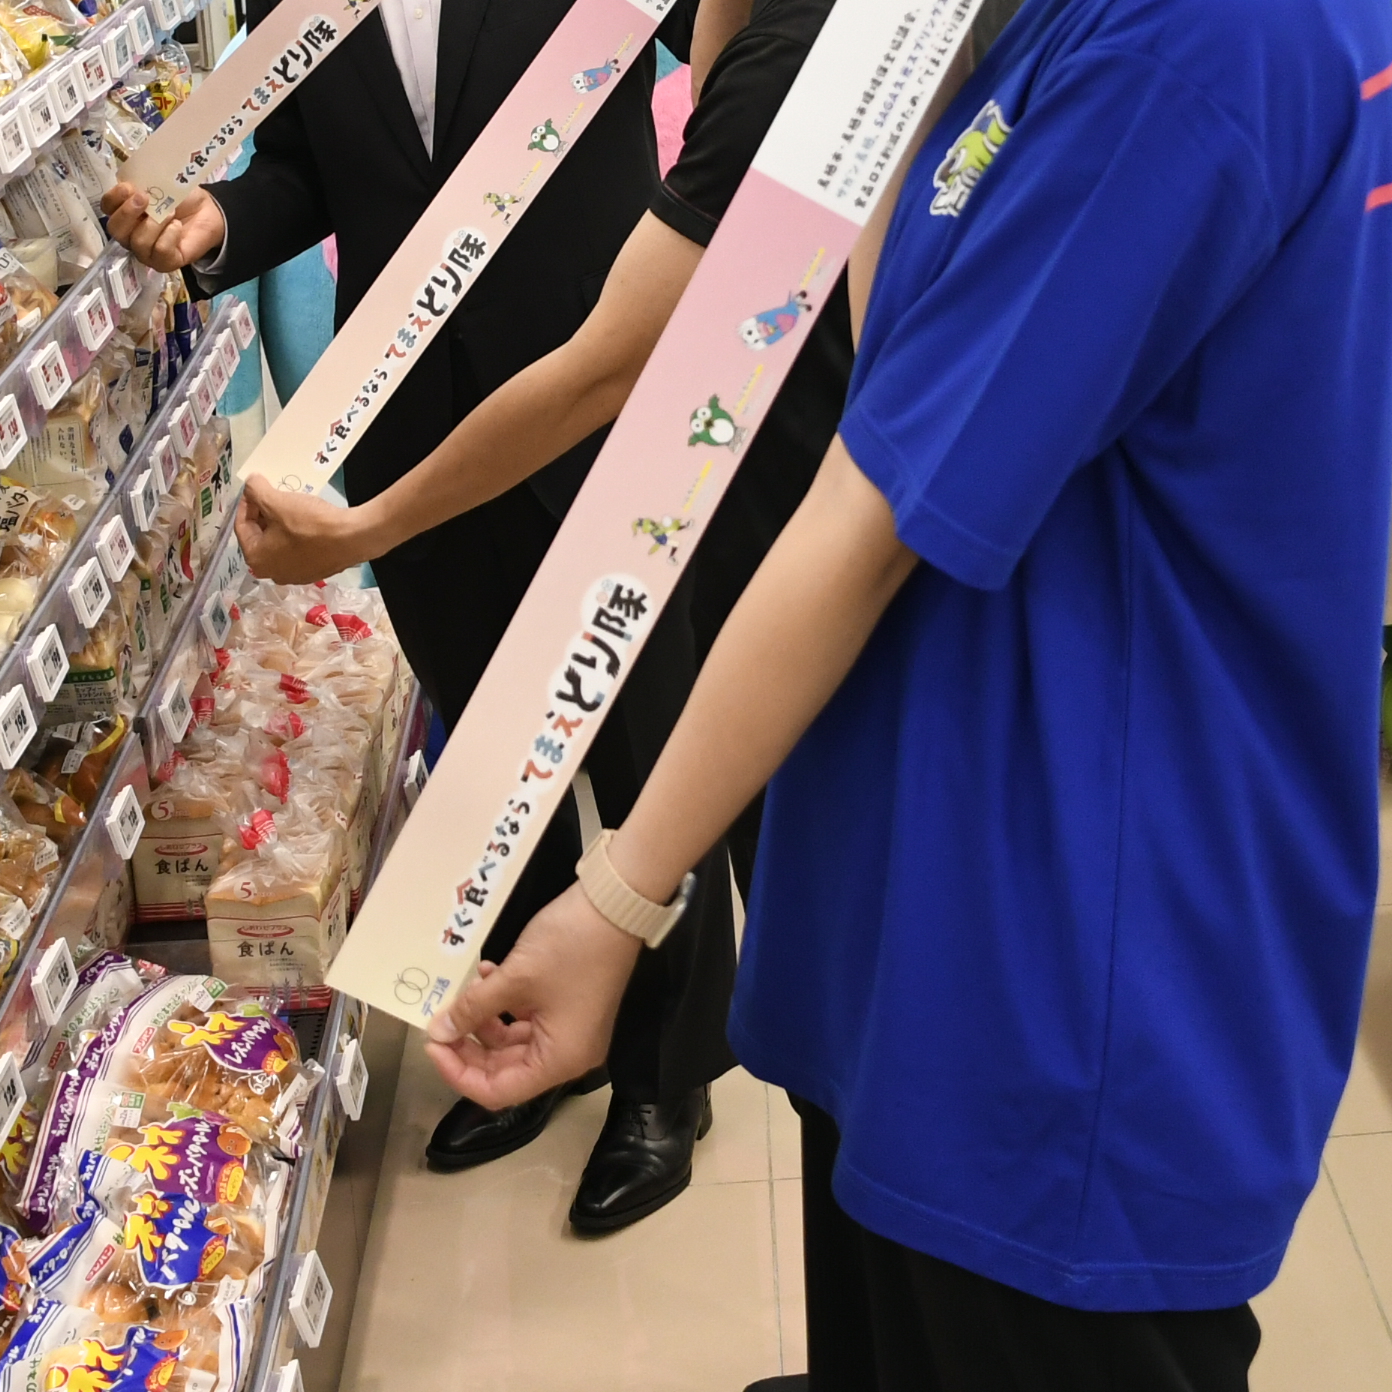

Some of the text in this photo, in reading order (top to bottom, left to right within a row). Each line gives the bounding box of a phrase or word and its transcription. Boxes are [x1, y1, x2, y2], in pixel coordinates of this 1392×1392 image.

[175, 19, 338, 185] すぐ食べるなら てまえどり隊
[314, 233, 487, 465] すぐ食べるなら てまえどり隊
[442, 583, 648, 947] すぐ食べるなら てまえどり隊
[158, 801, 169, 818] 5
[154, 855, 210, 875] 食ぱん
[240, 881, 254, 899] 5
[236, 938, 296, 960] 食ぱん
[422, 975, 451, 1018] デコ活
